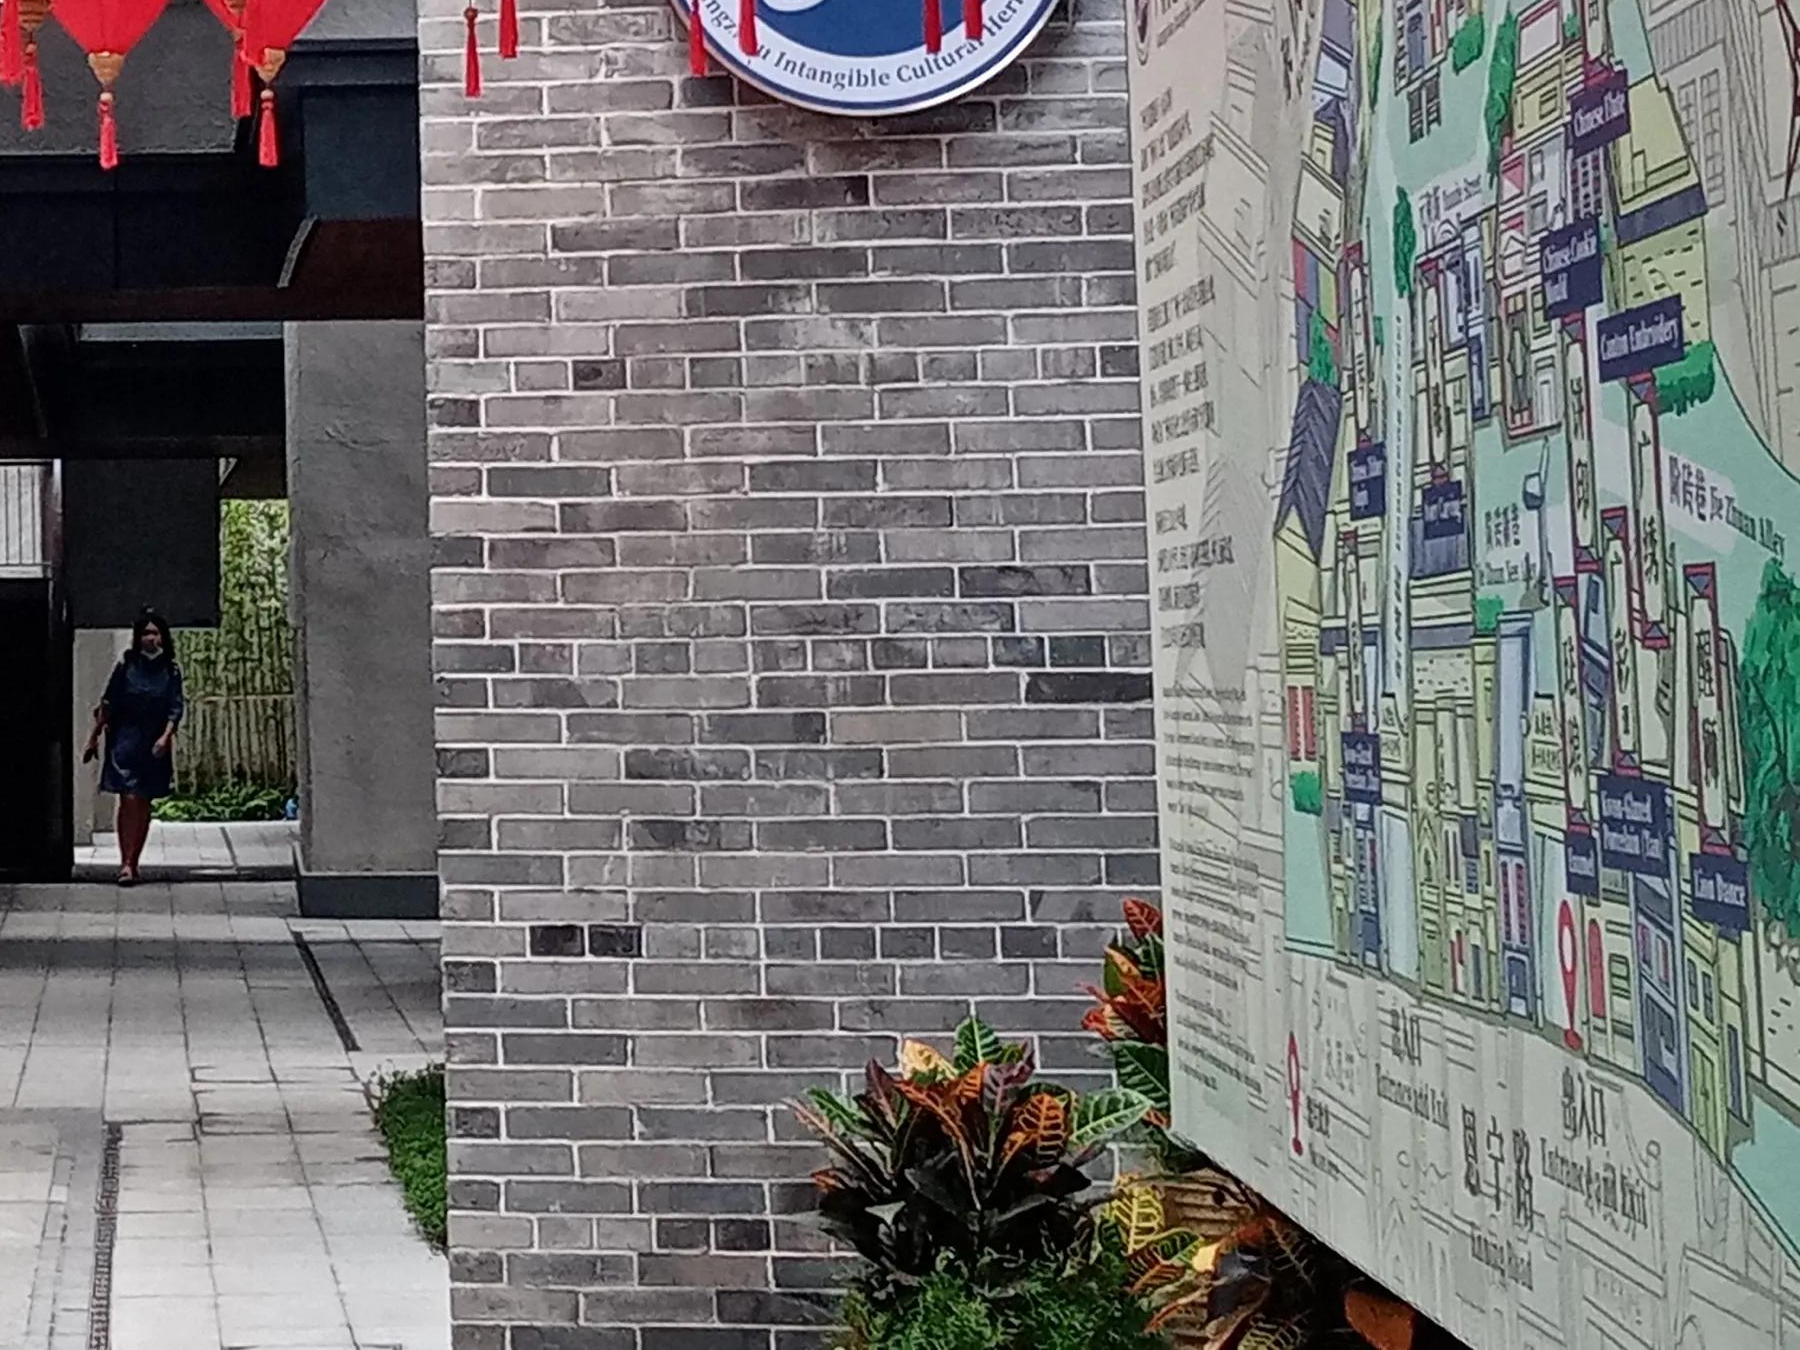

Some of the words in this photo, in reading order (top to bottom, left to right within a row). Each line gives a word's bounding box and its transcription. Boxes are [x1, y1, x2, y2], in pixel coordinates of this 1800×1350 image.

[773, 51, 891, 92] Intangible
[1461, 1104, 1535, 1232] 恩宁路
